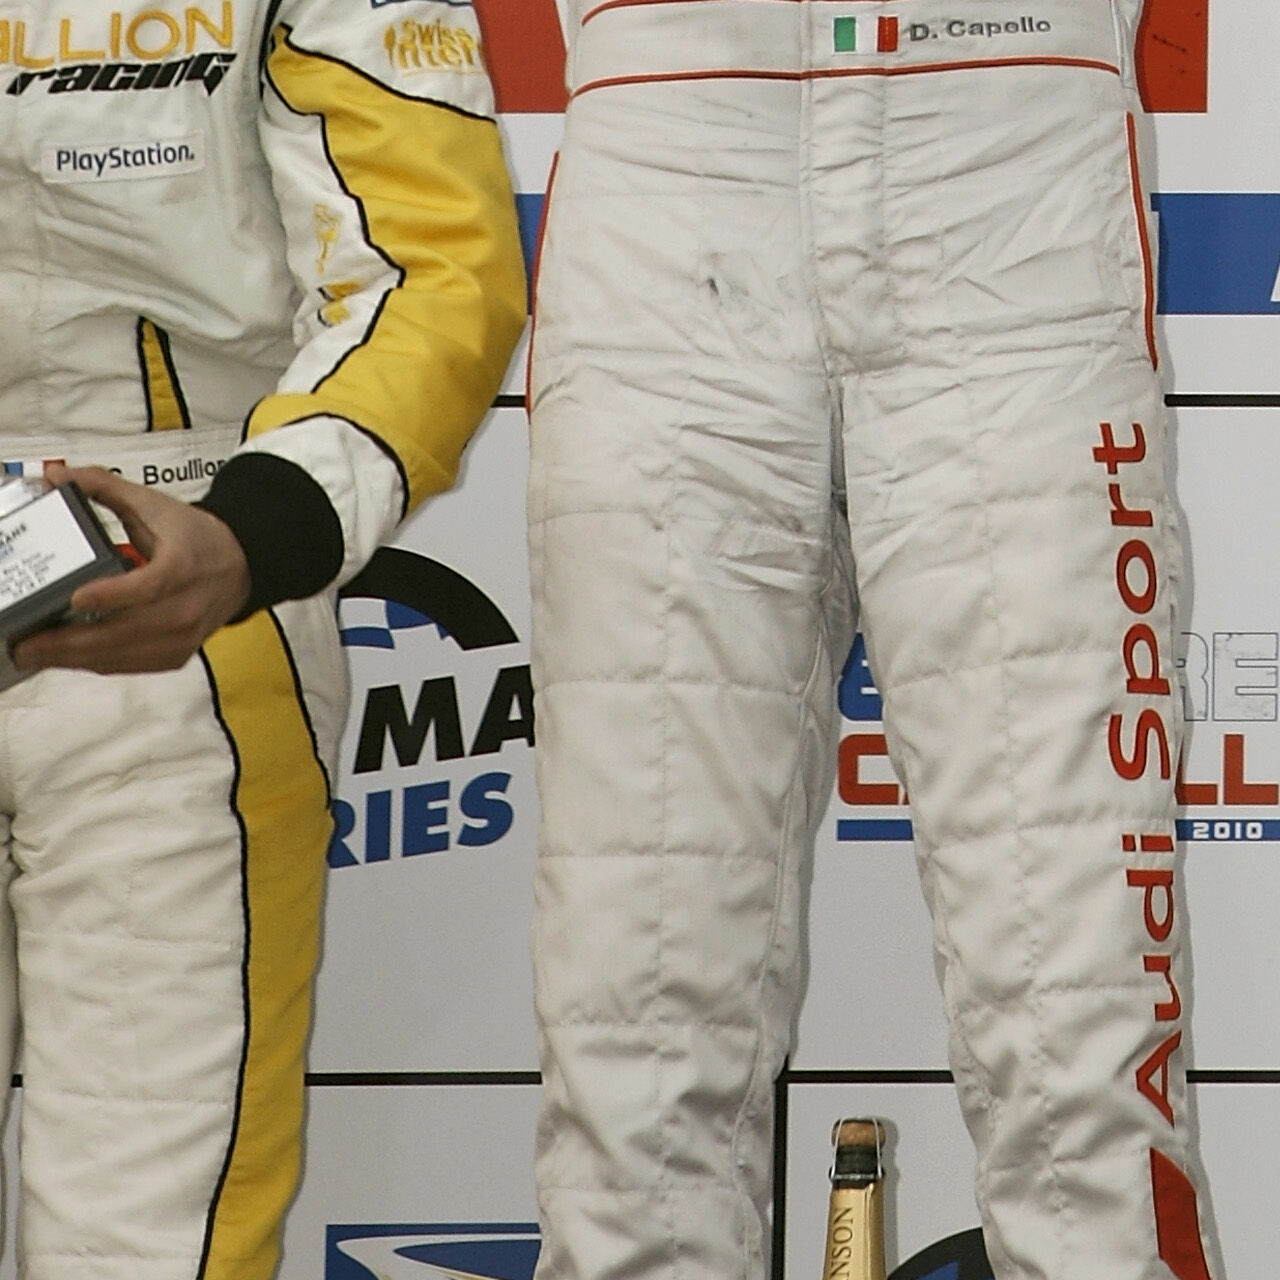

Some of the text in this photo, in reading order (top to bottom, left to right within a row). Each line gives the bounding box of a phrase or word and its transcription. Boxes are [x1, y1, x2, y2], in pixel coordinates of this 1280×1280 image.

[0, 0, 234, 69] LLION
[909, 22, 938, 42] D.
[1092, 421, 1172, 782] Sport
[352, 663, 537, 776] MA
[327, 771, 515, 870] RIES
[1192, 822, 1265, 842] 2010
[1121, 831, 1184, 1131] Audi
[830, 1206, 855, 1280] NSON
